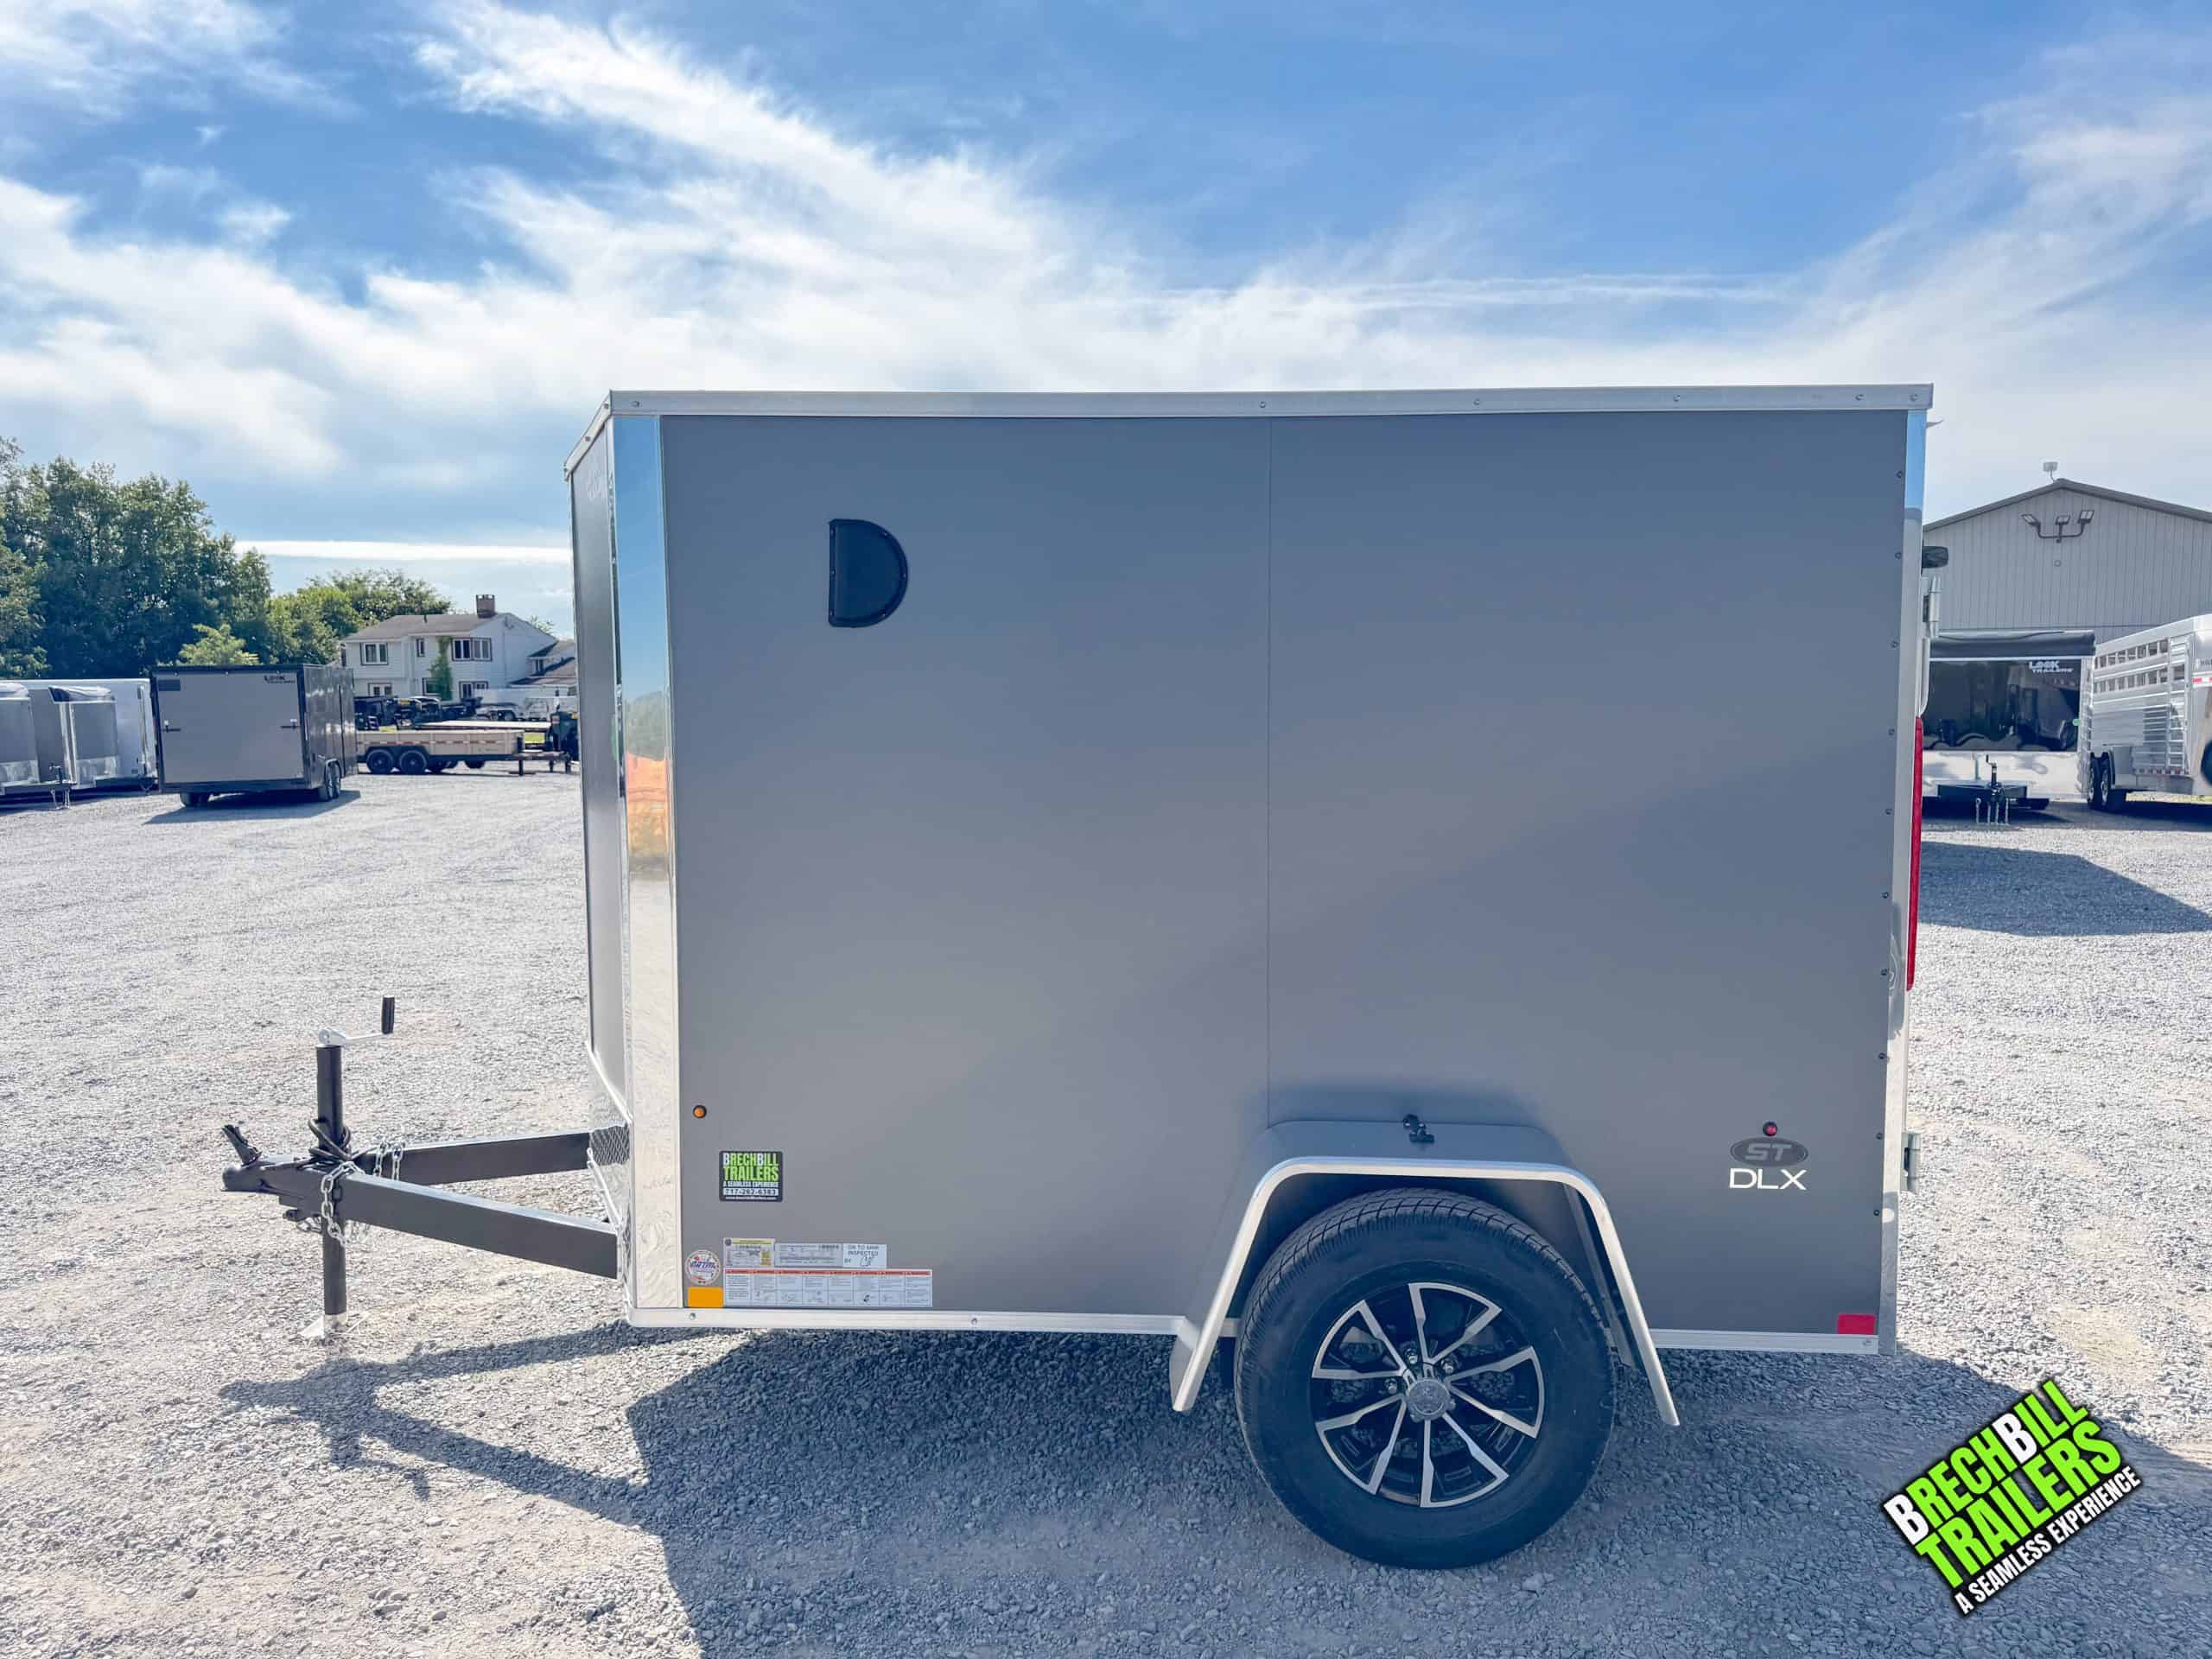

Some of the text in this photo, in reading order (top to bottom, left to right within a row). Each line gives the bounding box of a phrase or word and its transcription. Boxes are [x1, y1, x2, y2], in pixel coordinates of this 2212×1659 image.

[723, 1153, 779, 1166] BRECHBILL
[1744, 1143, 1792, 1161] ST
[723, 1166, 779, 1181] TRAILERS
[1729, 1167, 1807, 1190] DLX
